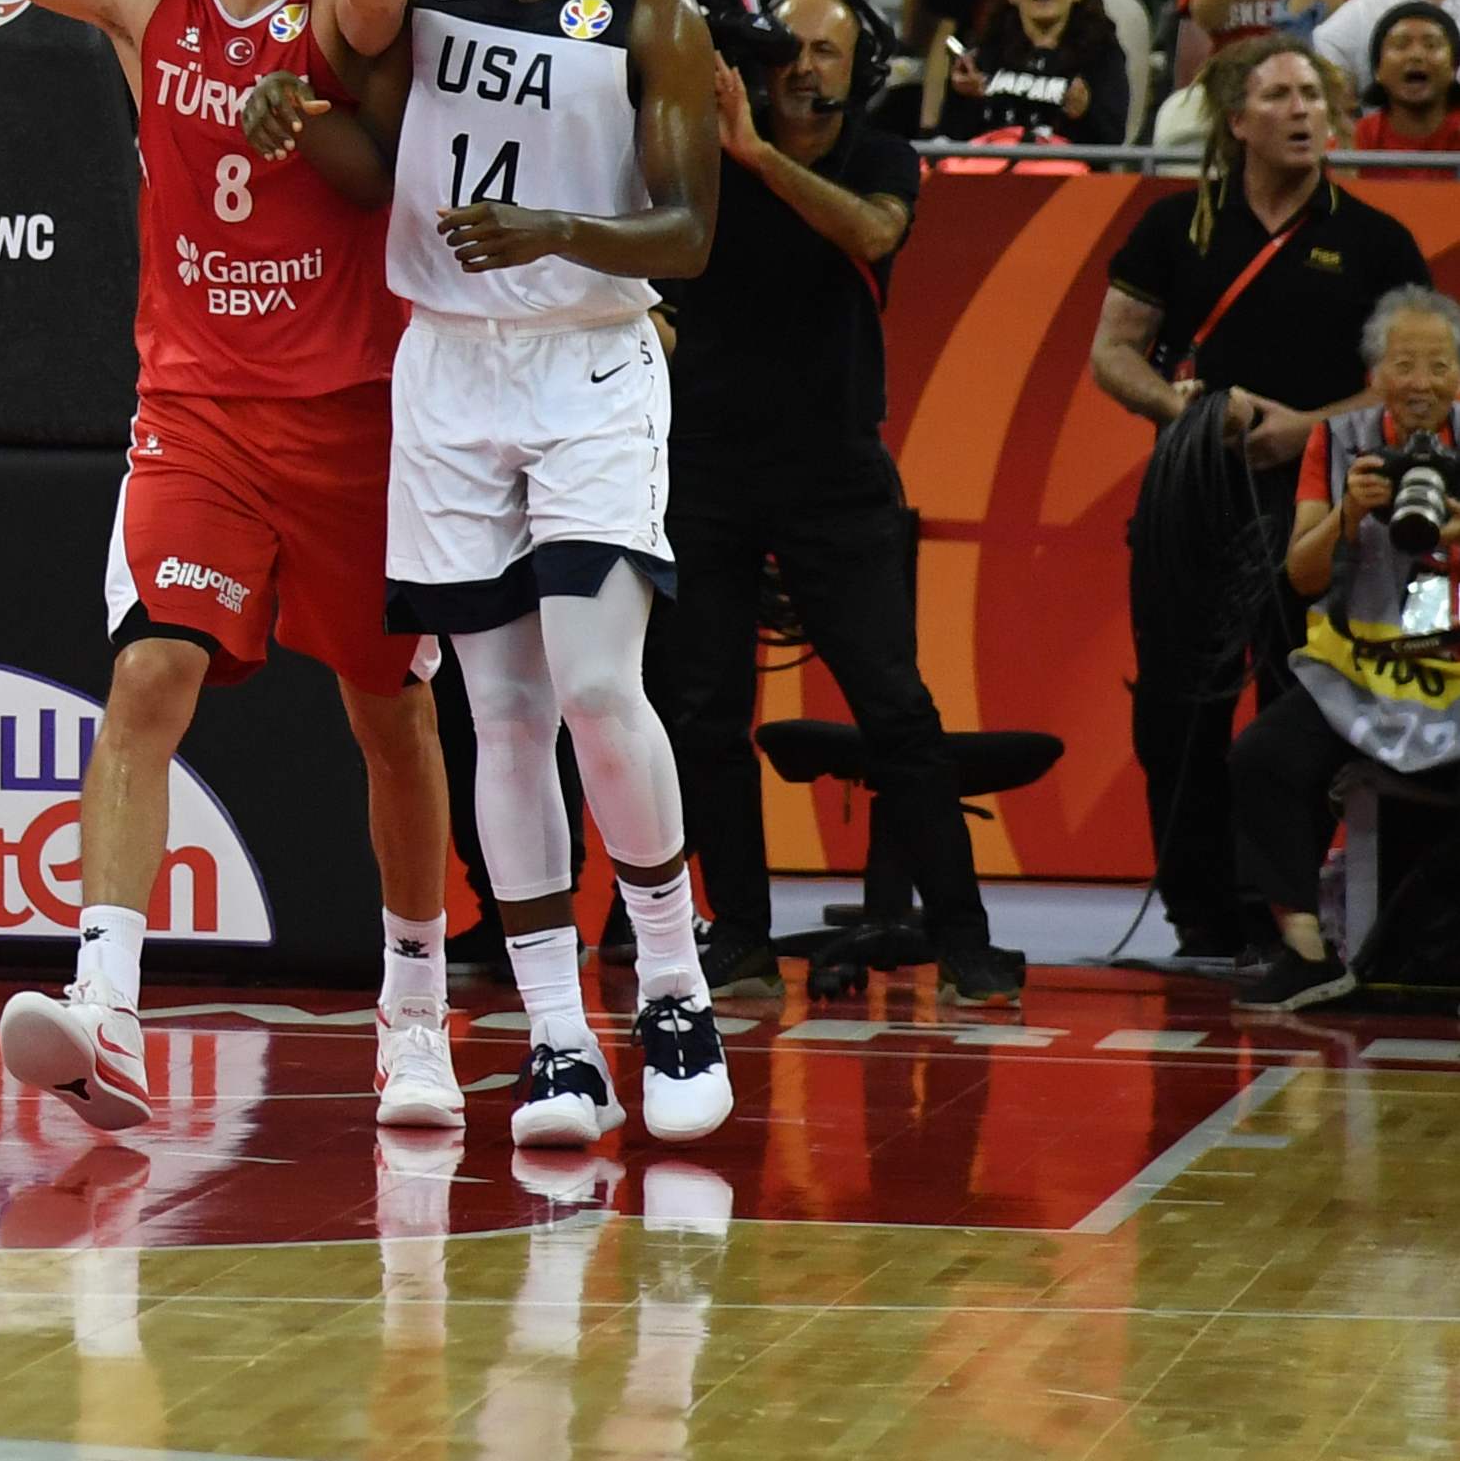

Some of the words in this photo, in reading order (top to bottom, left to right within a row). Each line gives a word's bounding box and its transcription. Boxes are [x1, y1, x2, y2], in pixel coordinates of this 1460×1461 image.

[156, 57, 310, 129] TÜRK
[436, 35, 553, 111] USA
[213, 153, 253, 224] 8
[452, 133, 521, 208] 14
[202, 248, 324, 285] Garanti
[207, 286, 297, 317] BBVA
[154, 555, 252, 602] Bilyoner
